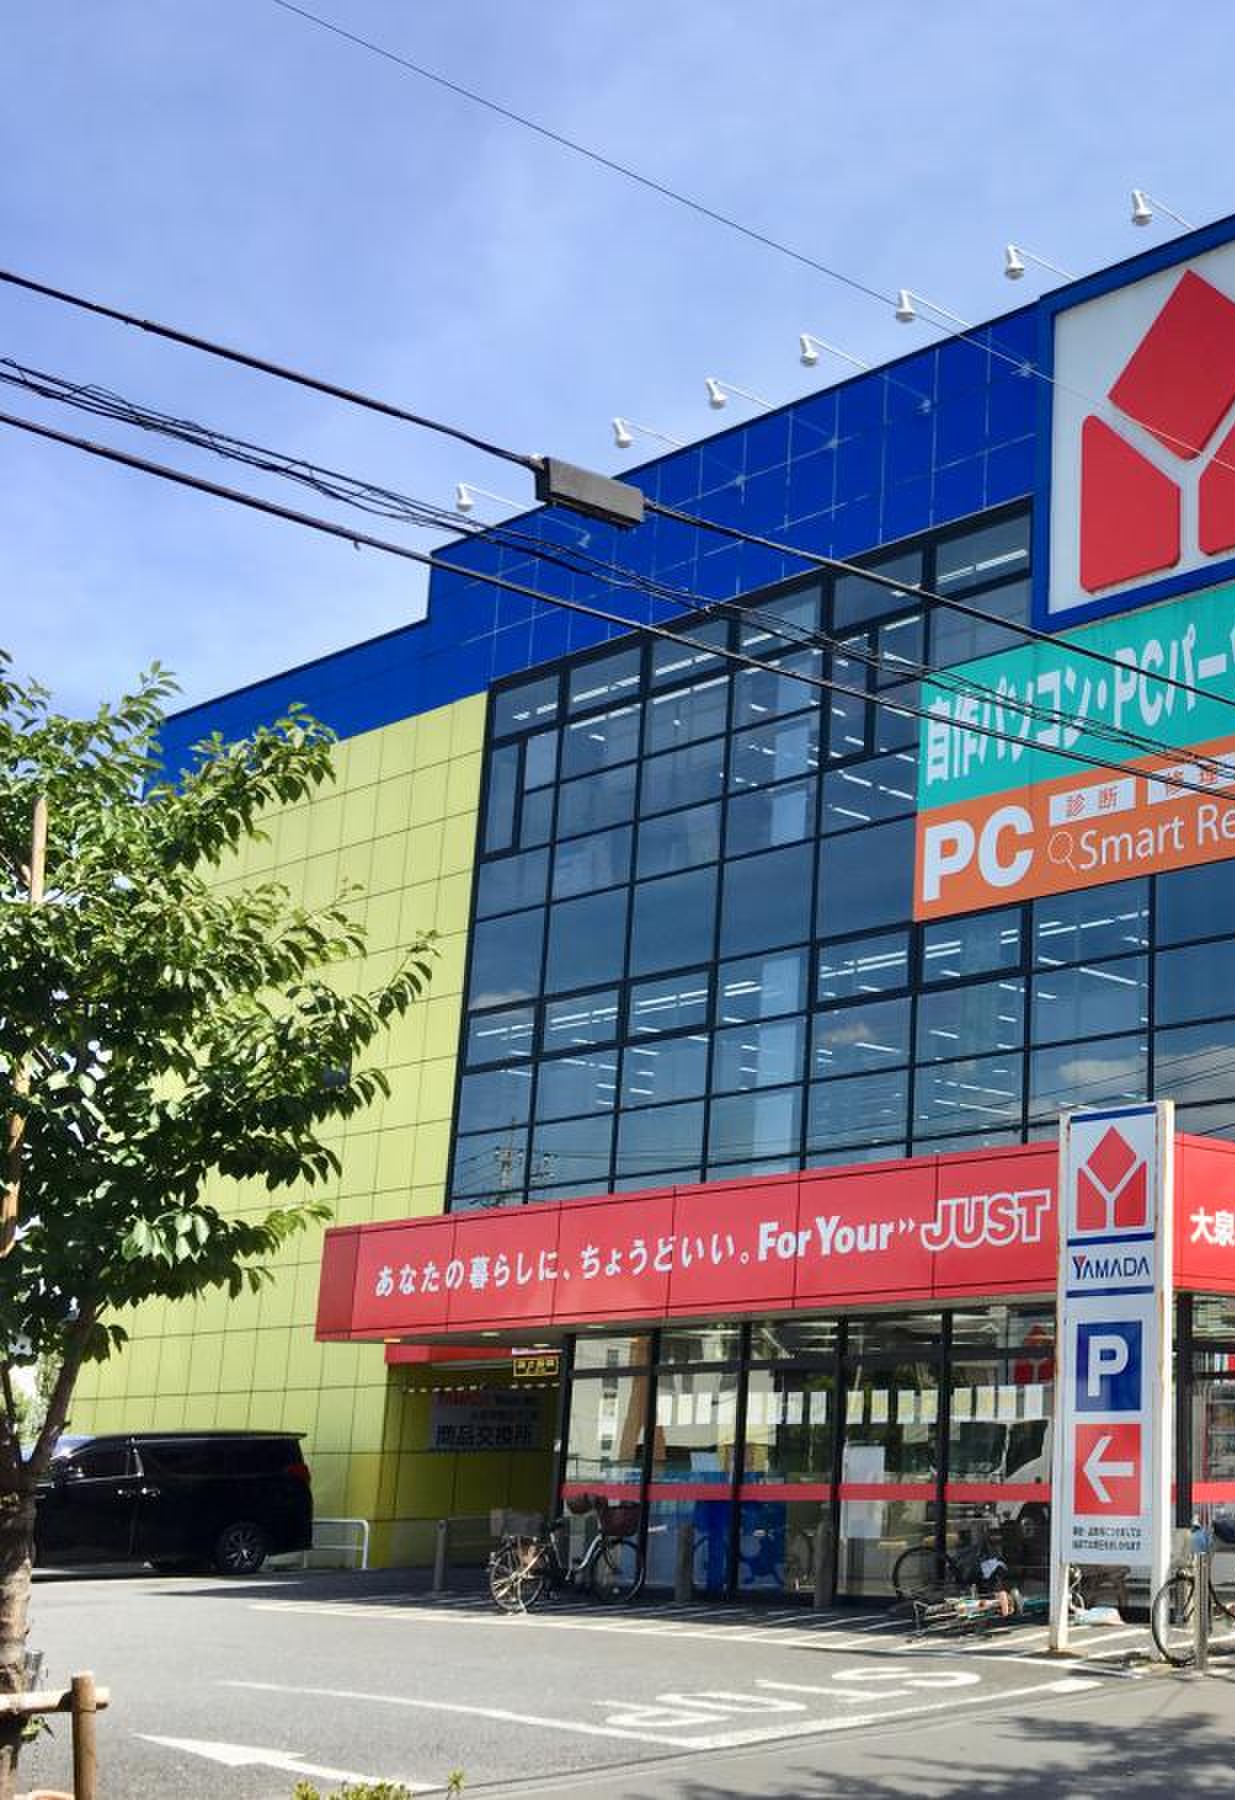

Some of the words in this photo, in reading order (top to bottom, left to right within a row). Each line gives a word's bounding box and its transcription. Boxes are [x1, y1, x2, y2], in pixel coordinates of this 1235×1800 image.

[923, 806, 1034, 902] PC
[1078, 815, 1185, 872] Smart
[920, 1188, 1051, 1251] JUST
[1071, 1255, 1151, 1281] YAMADA
[1086, 1334, 1130, 1397] P
